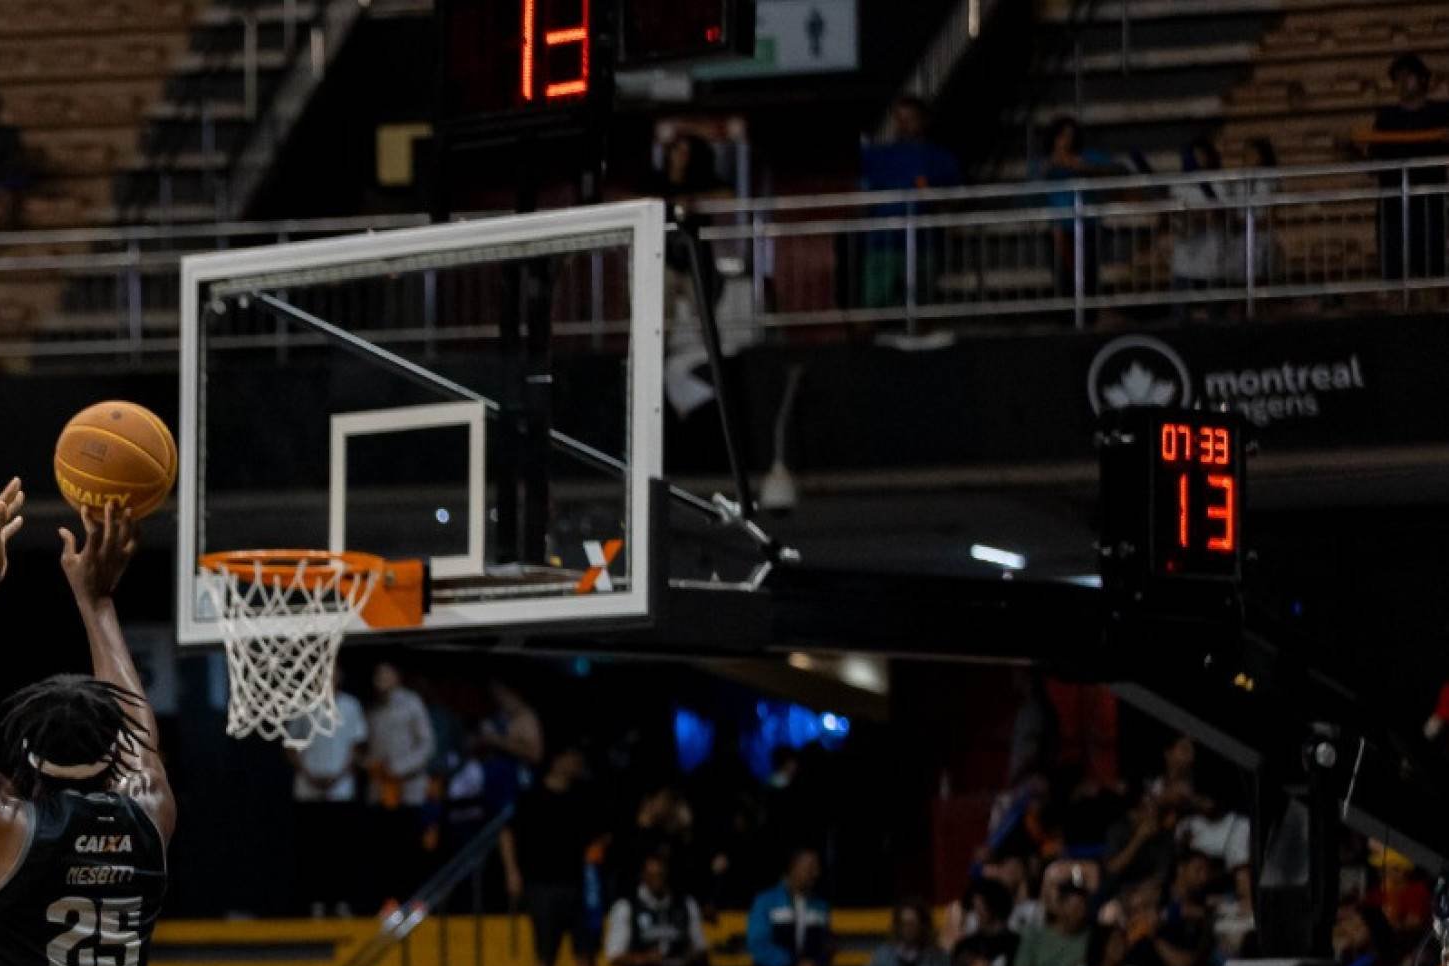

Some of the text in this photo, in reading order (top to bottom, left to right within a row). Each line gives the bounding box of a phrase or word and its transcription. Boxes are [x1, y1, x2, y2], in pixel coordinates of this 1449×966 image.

[1206, 356, 1363, 397] montreal
[1176, 472, 1235, 551] 13
[75, 834, 132, 853] CAIXA
